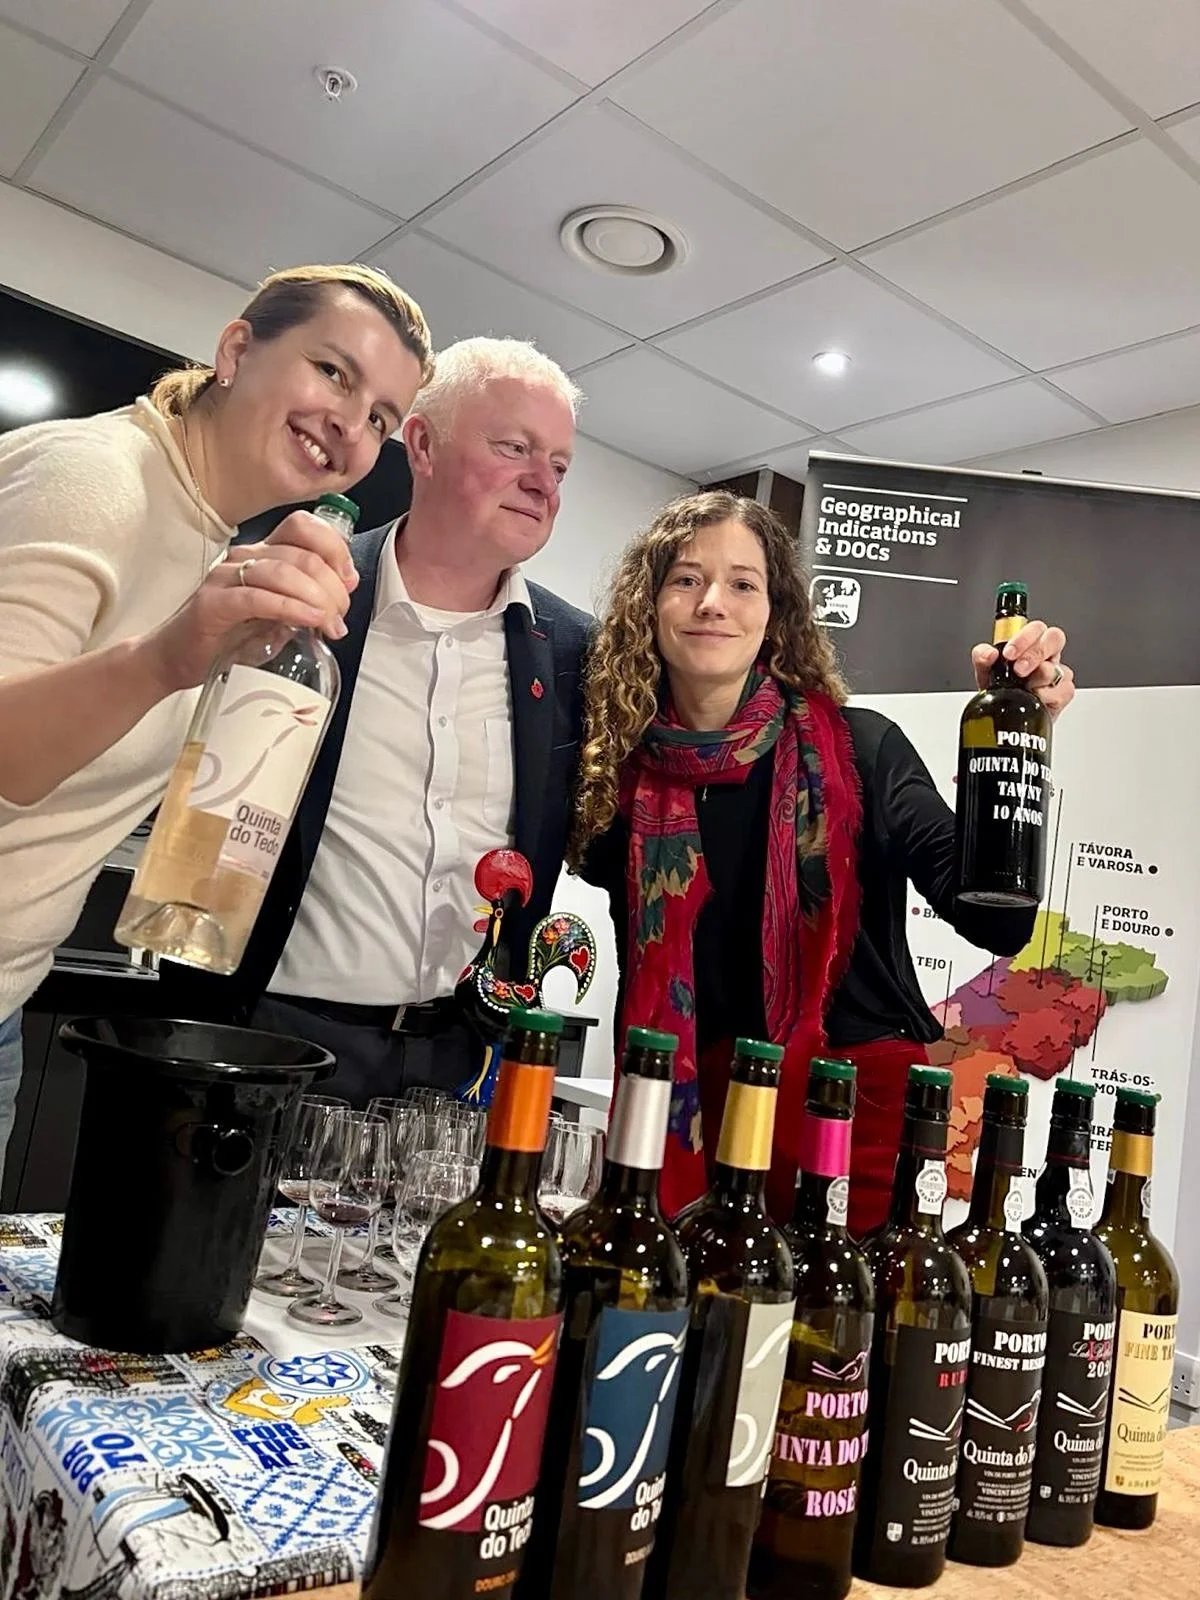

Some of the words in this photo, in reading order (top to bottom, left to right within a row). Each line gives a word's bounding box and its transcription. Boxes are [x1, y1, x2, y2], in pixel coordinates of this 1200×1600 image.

[820, 496, 961, 529] Geographical
[817, 517, 937, 547] Indications
[815, 538, 831, 555] &
[835, 540, 890, 562] DOCs
[997, 731, 1047, 752] PORTO
[969, 757, 1019, 774] QUINTA
[1024, 760, 1039, 777] DO
[998, 781, 1042, 802] TAWNY
[237, 804, 281, 836] Quinta
[993, 805, 1010, 820] 10
[1013, 807, 1043, 826] ANOS
[230, 825, 251, 844] do
[1078, 842, 1133, 859] TÁVORA
[1077, 856, 1084, 866] E
[1088, 857, 1143, 874] VAROSA
[1102, 905, 1149, 920] PORTO
[1101, 919, 1109, 930] E
[1112, 921, 1160, 937] DOURO
[917, 956, 946, 970] TEJO
[1091, 1068, 1155, 1086] TRÁS-OS-
[1095, 1083, 1117, 1096] MO
[1021, 1168, 1037, 1179] EN
[993, 1331, 1047, 1353] PORTO
[1124, 1342, 1158, 1361] FINE
[972, 1351, 1020, 1371] FINEST
[805, 1389, 869, 1419] PORTO
[231, 1422, 300, 1444] POR
[1054, 1430, 1095, 1453] Quinta
[1117, 1422, 1156, 1443] Quinta
[92, 1433, 148, 1469] TO
[249, 1437, 311, 1457] TUG
[774, 1432, 832, 1467] INTA
[837, 1437, 860, 1466] DO
[963, 1439, 1013, 1467] Quinta
[1015, 1446, 1028, 1466] do
[62, 1440, 105, 1494] POR
[259, 1451, 298, 1470] AL
[903, 1458, 949, 1484] Quinta
[805, 1480, 857, 1517] ROSÉ
[630, 1507, 650, 1531] do
[480, 1532, 507, 1560] do
